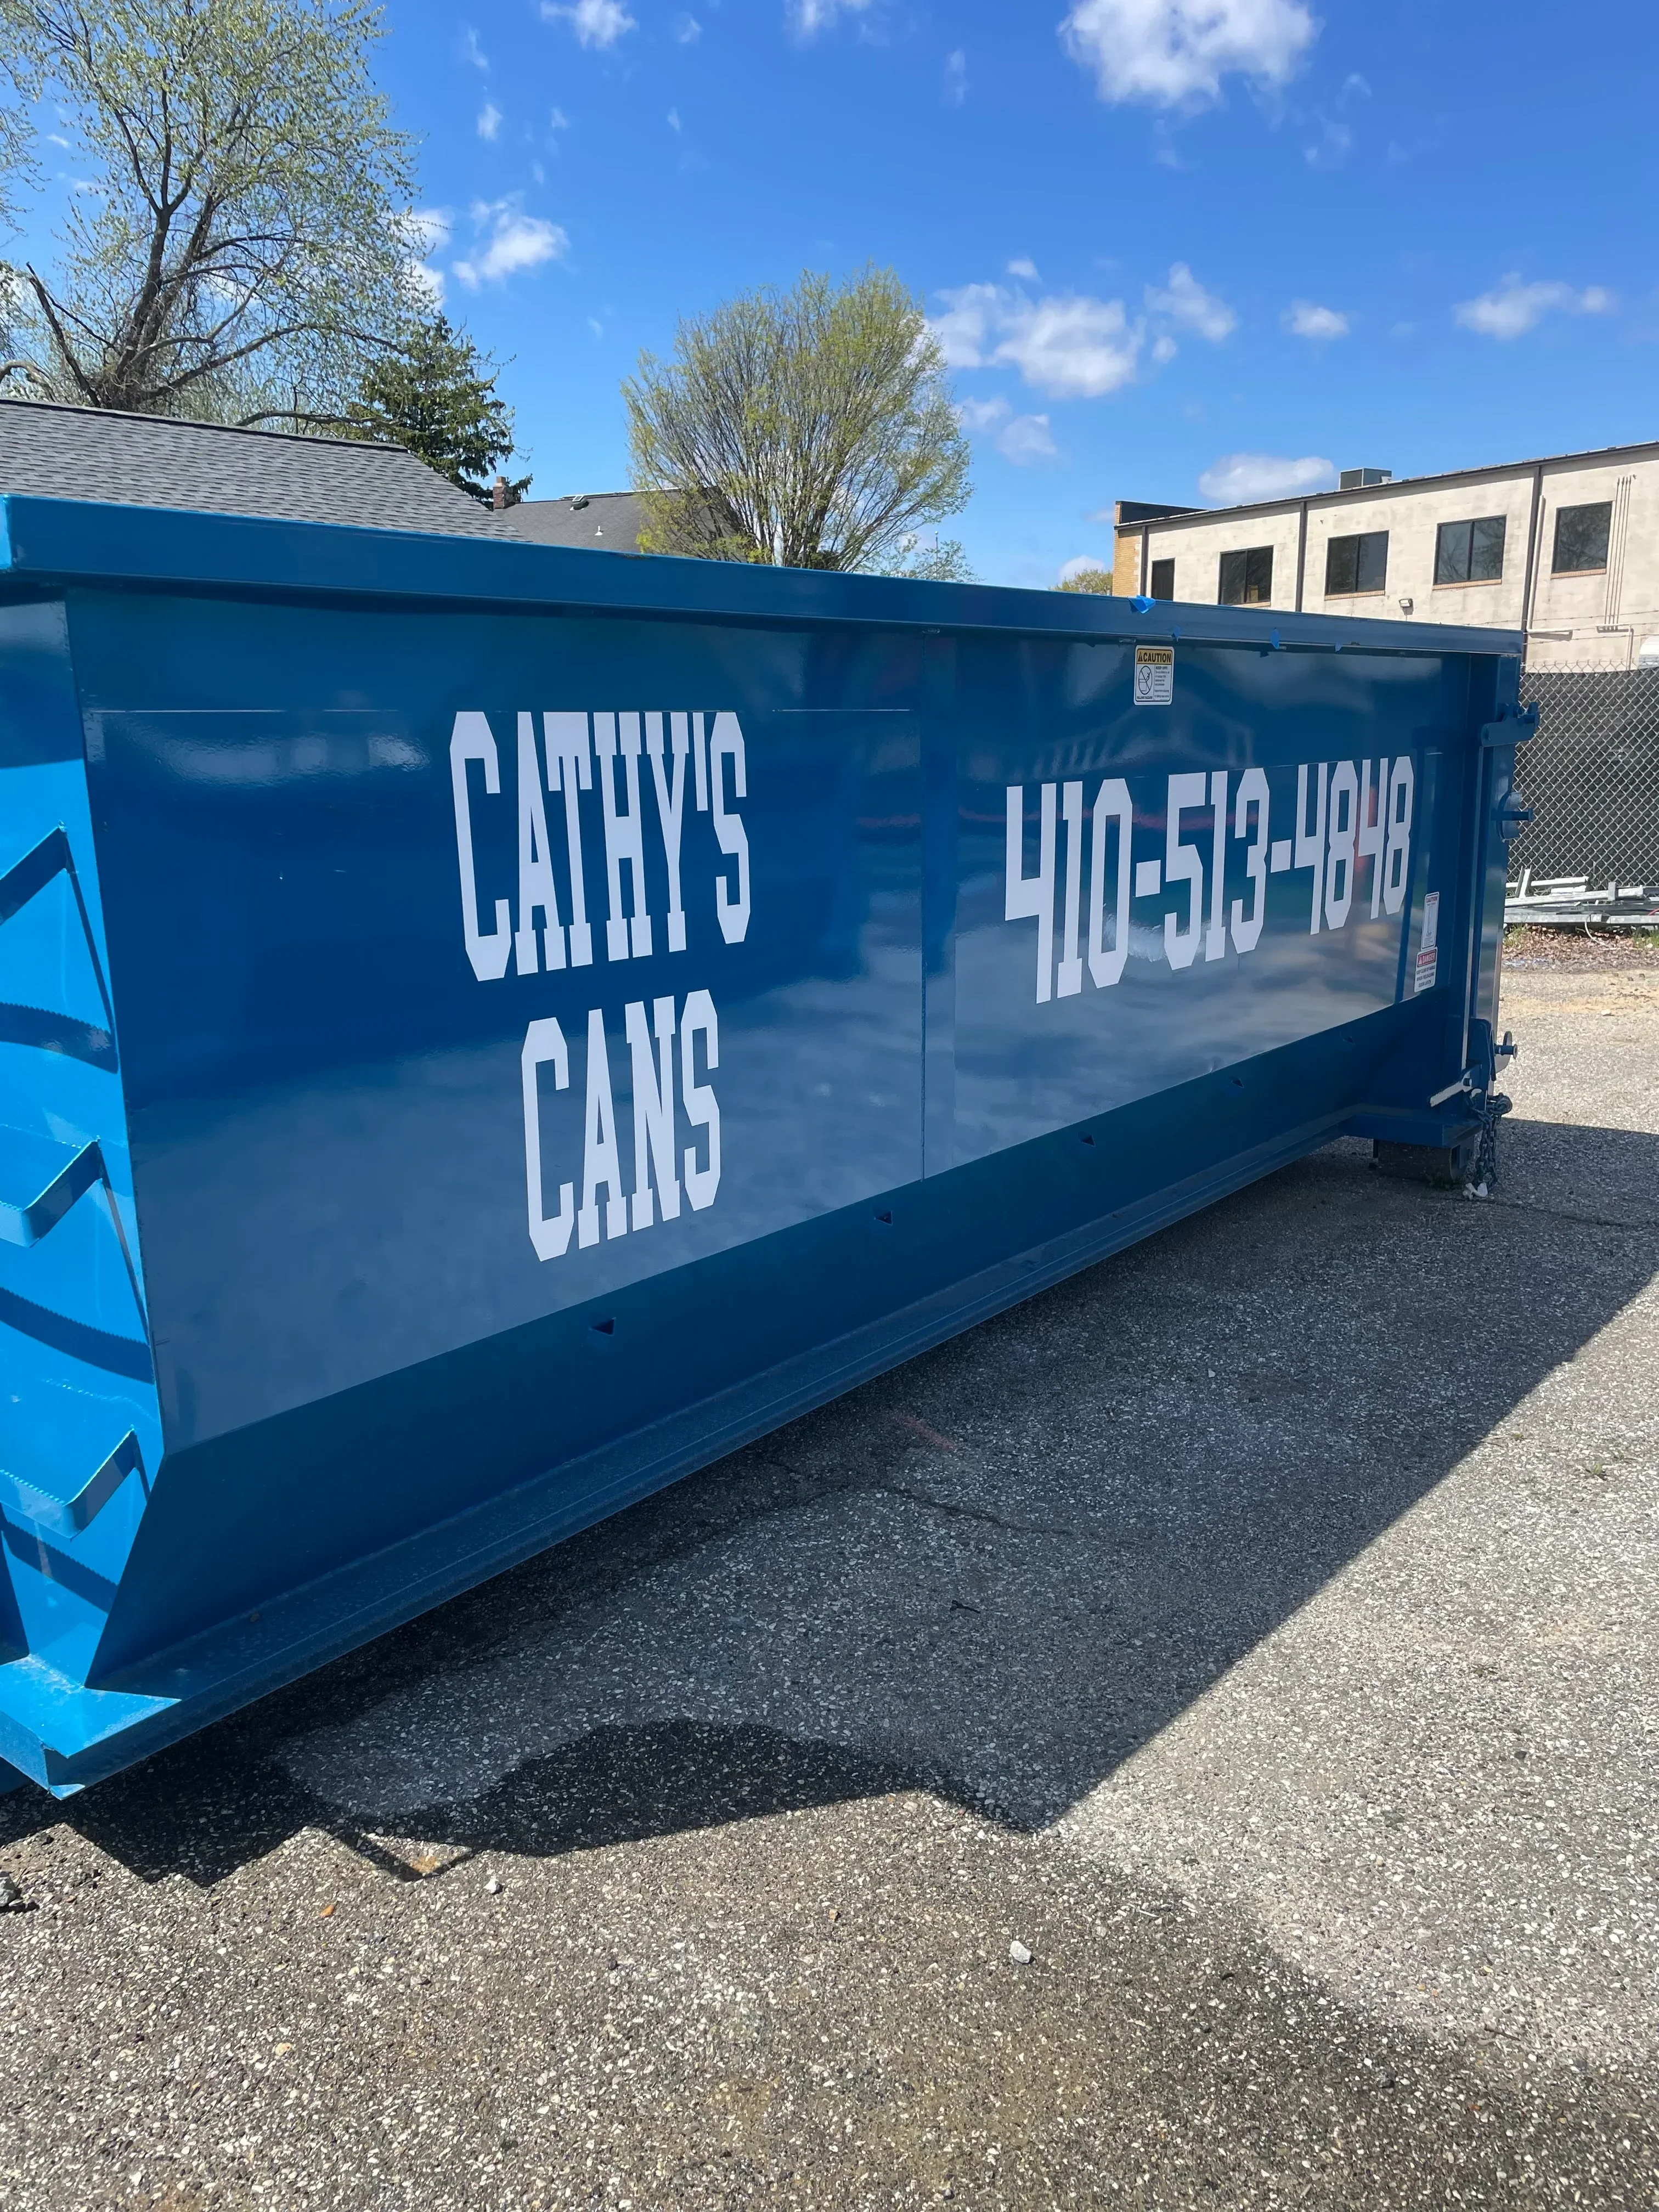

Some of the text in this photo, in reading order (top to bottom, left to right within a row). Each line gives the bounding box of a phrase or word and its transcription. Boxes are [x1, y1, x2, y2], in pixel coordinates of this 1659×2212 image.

[1143, 652, 1171, 663] CAUTION
[449, 711, 750, 981] CATHY'S
[1005, 756, 1414, 1004] 410-513-4848
[1422, 952, 1436, 964] DANGER
[521, 989, 721, 1262] CANS
